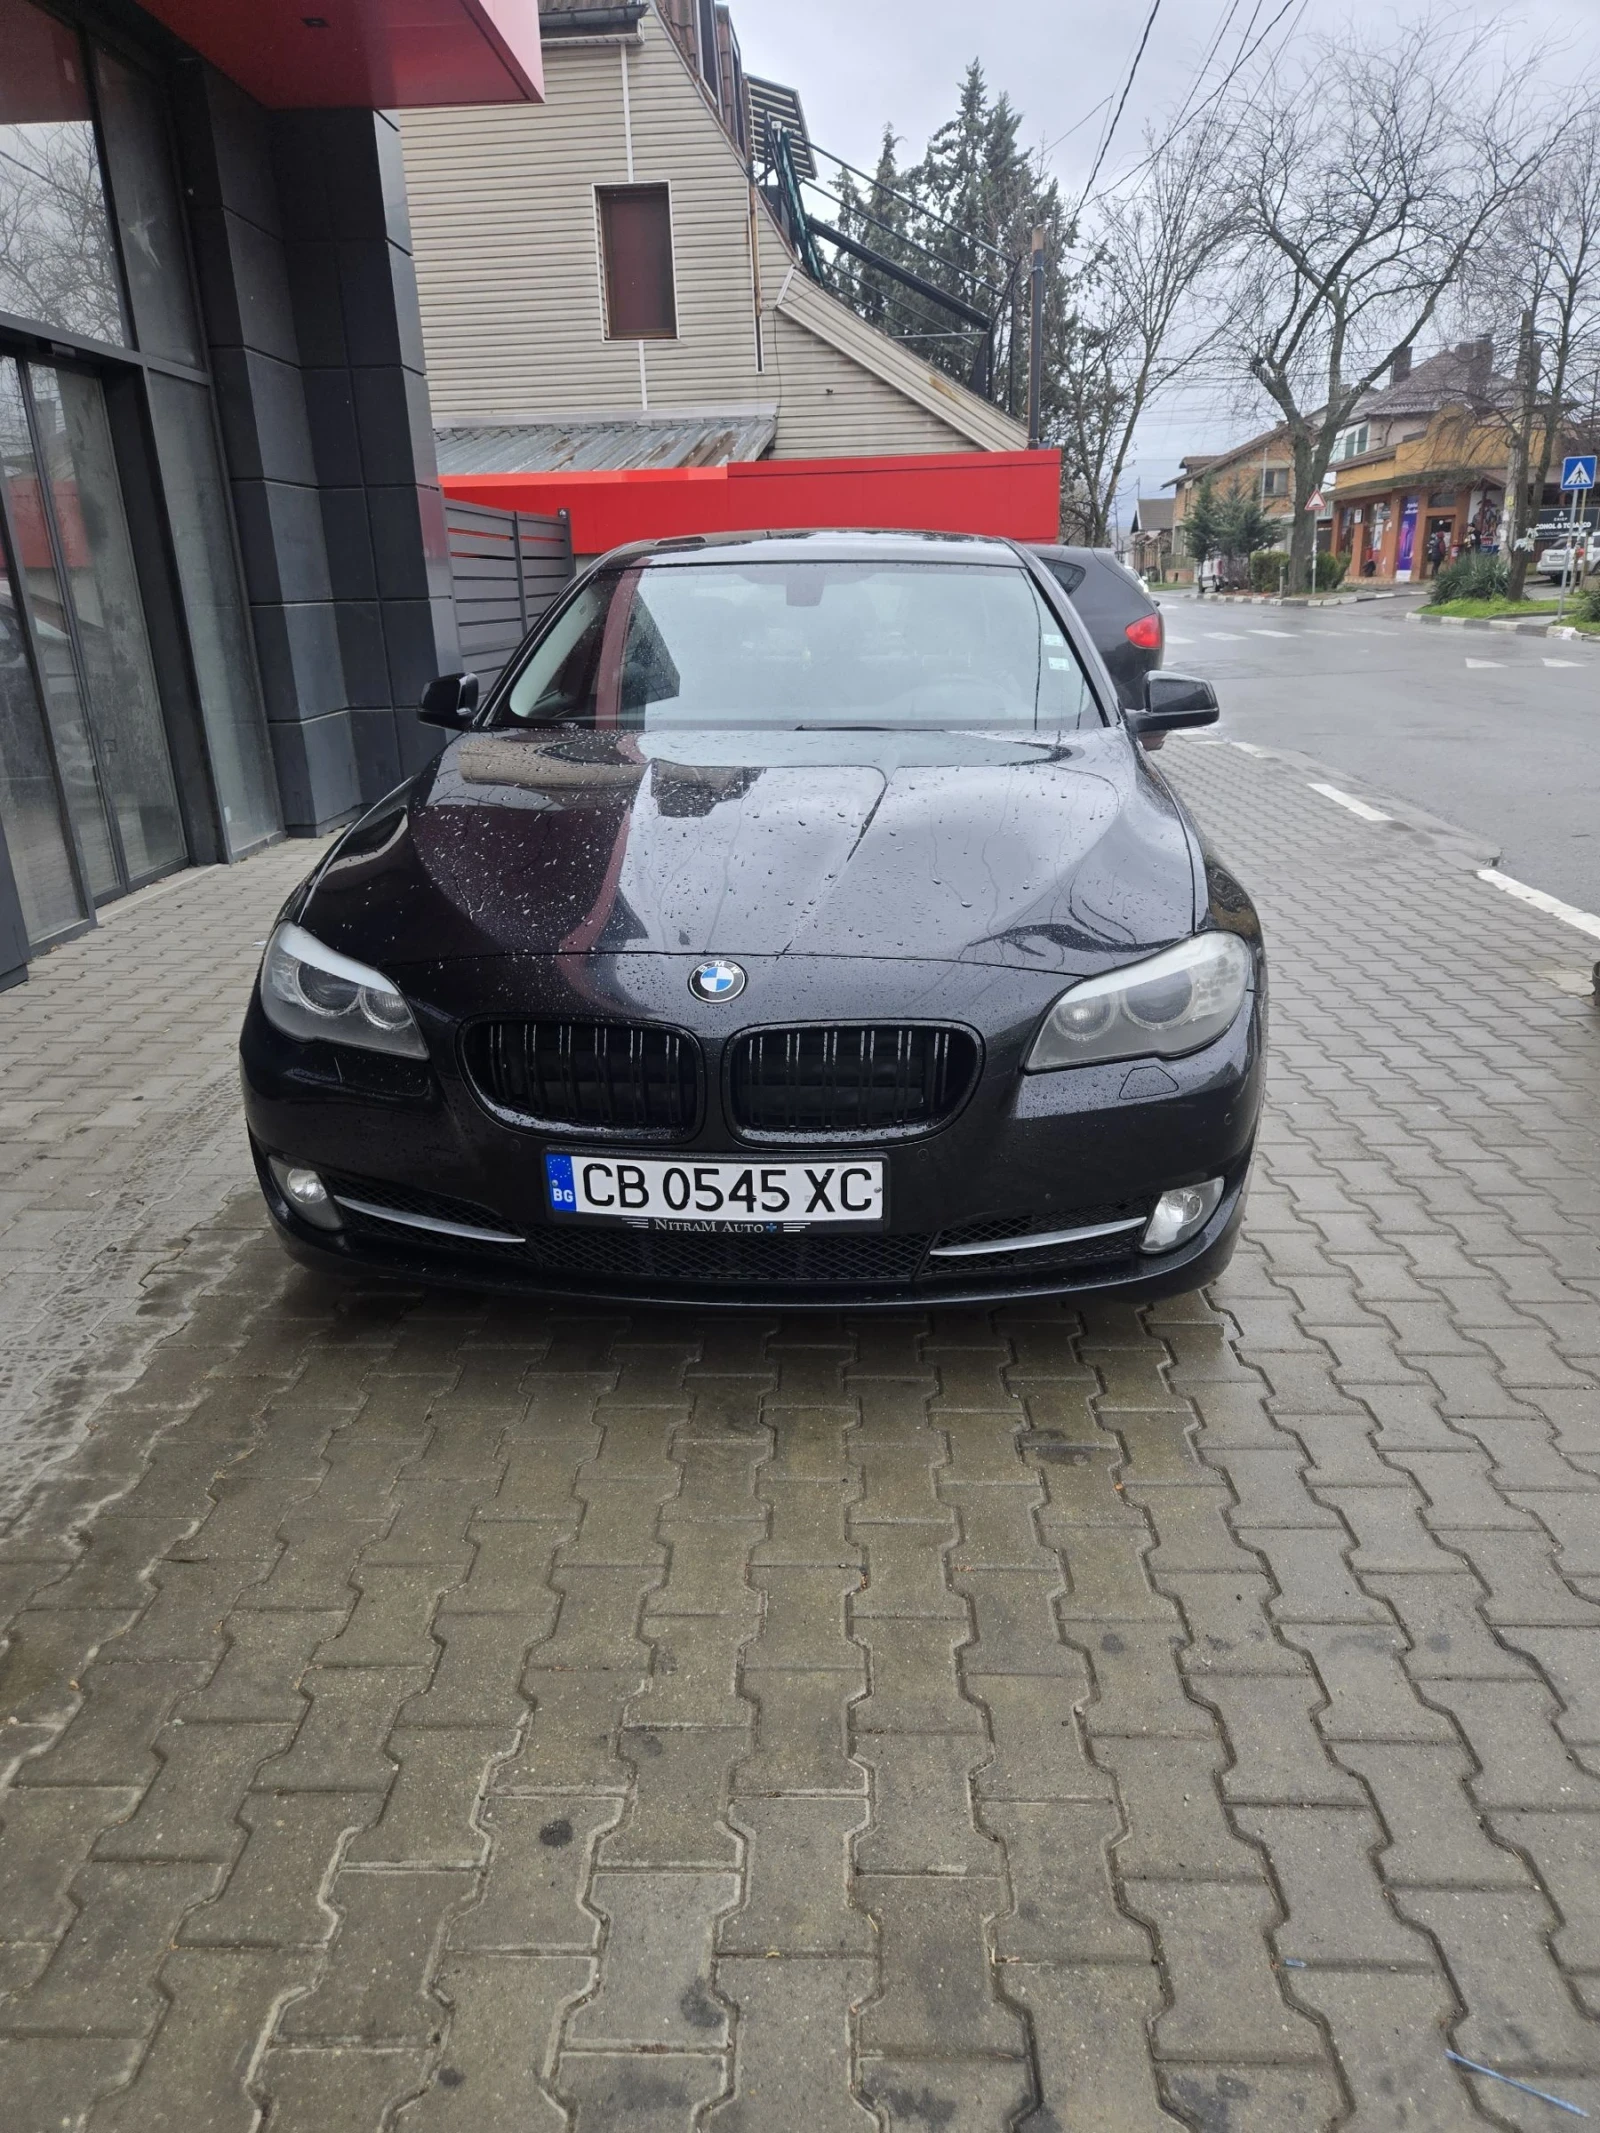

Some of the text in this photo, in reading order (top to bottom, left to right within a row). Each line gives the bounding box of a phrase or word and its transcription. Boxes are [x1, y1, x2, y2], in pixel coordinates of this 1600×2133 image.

[699, 960, 741, 974] BMW
[552, 1187, 574, 1203] BG
[583, 1163, 872, 1213] CB 0545 XC
